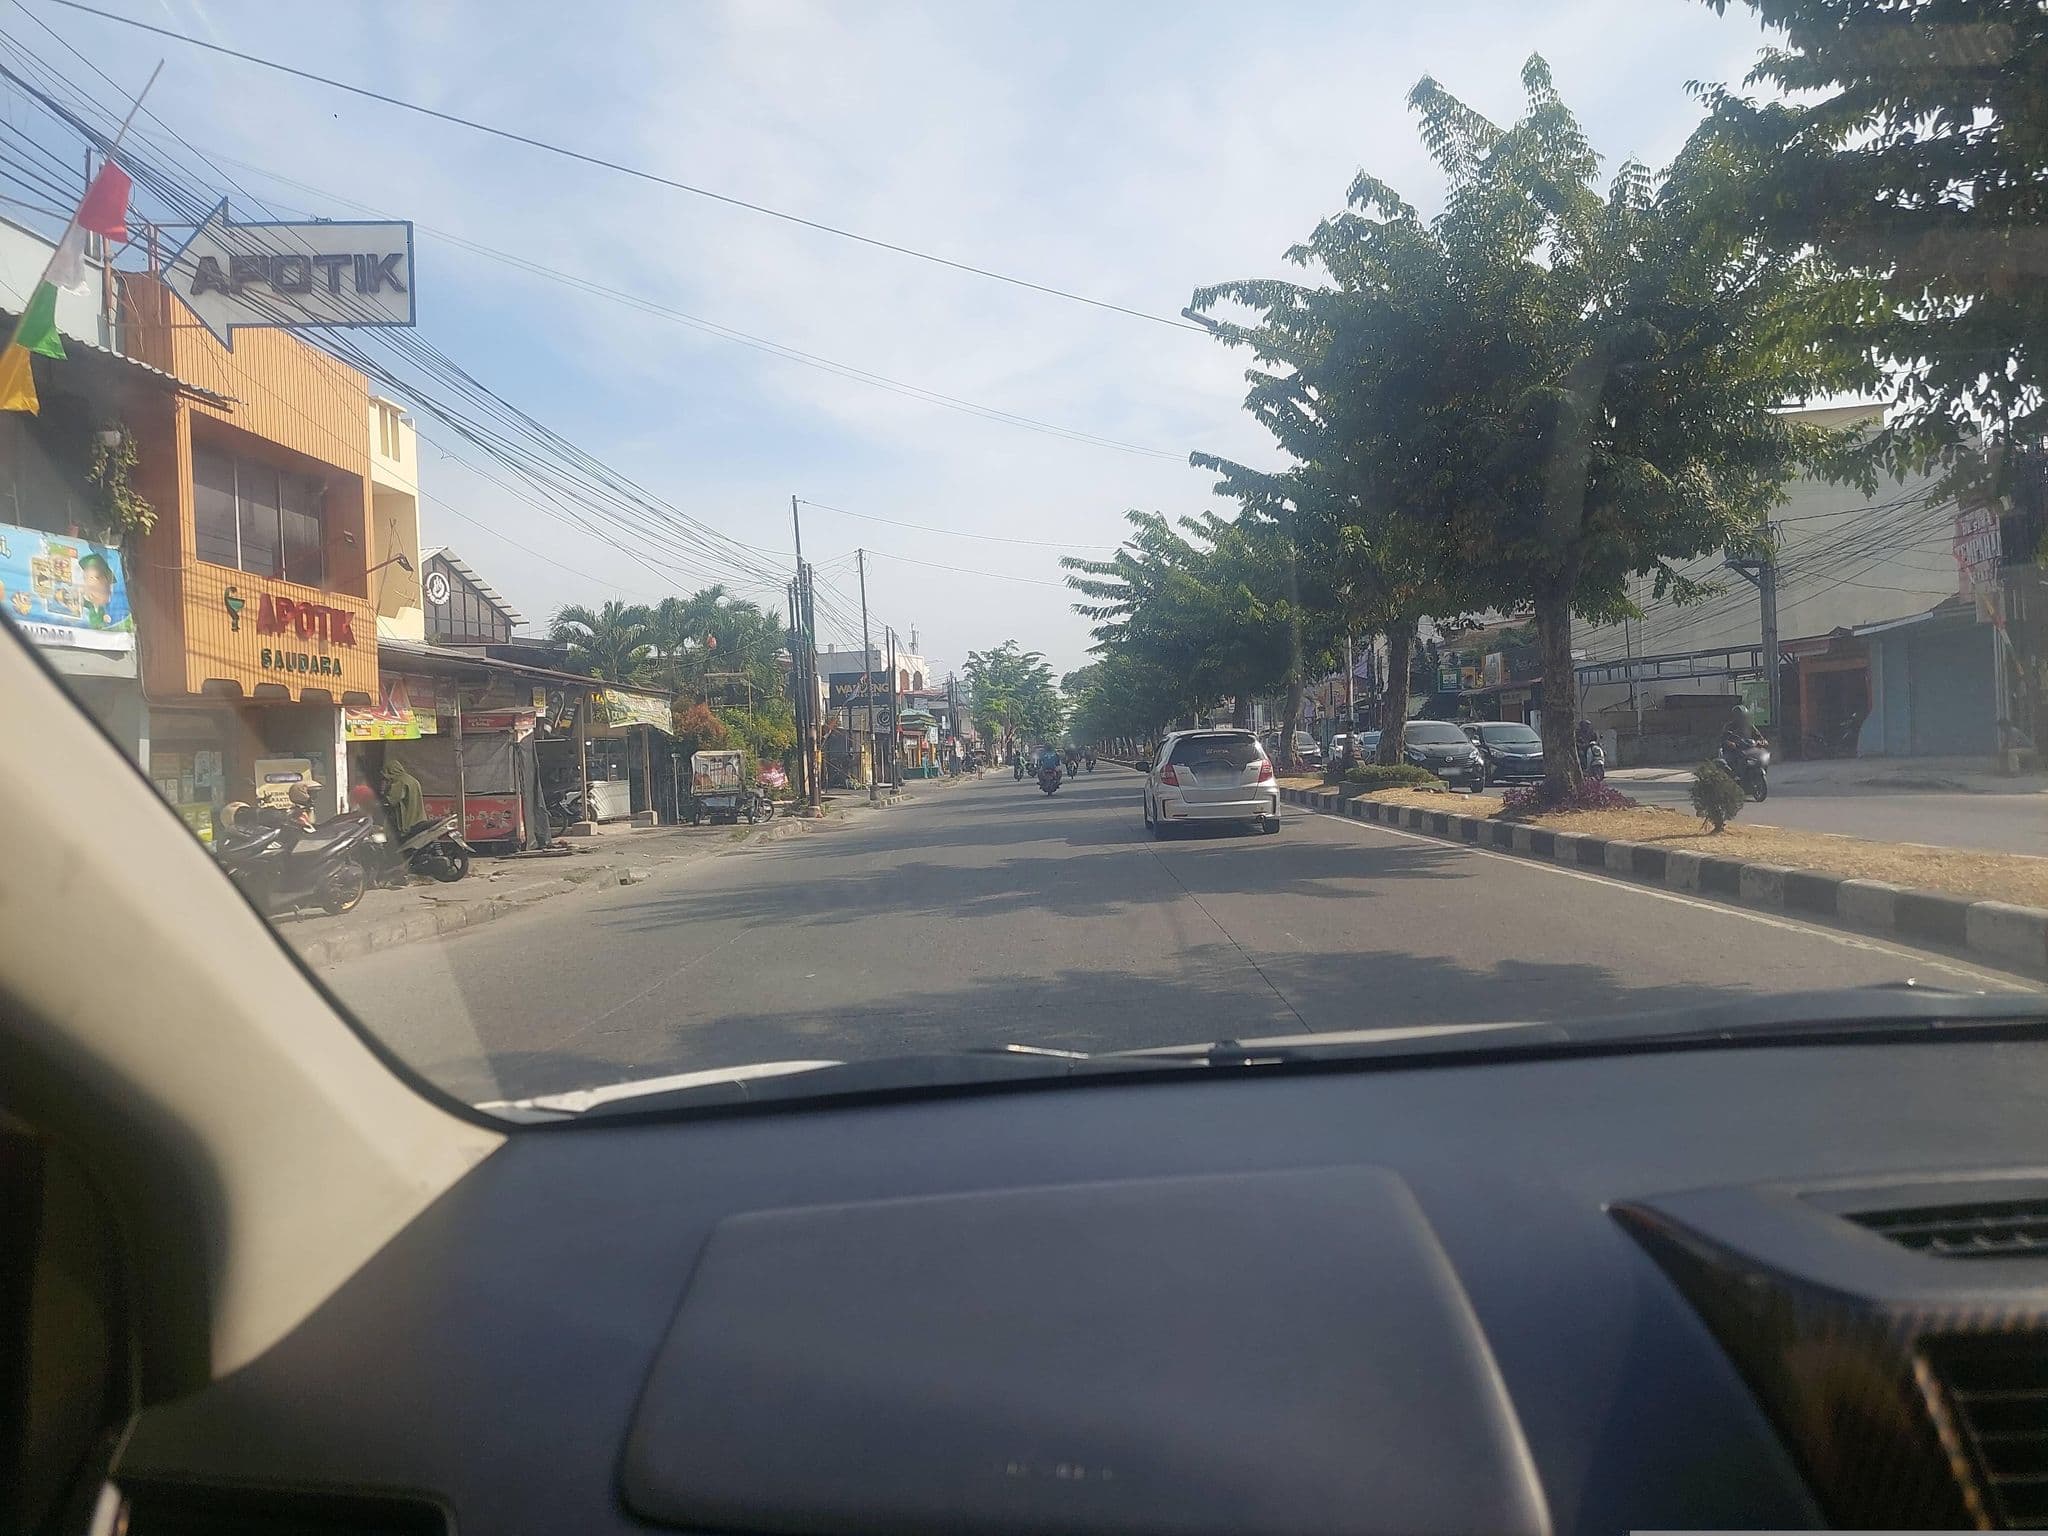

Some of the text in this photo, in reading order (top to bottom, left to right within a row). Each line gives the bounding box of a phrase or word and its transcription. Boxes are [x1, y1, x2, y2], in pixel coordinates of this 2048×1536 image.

[190, 252, 407, 296] APOTIK
[256, 592, 357, 649] APOTIK
[261, 648, 342, 677] SAUDARA
